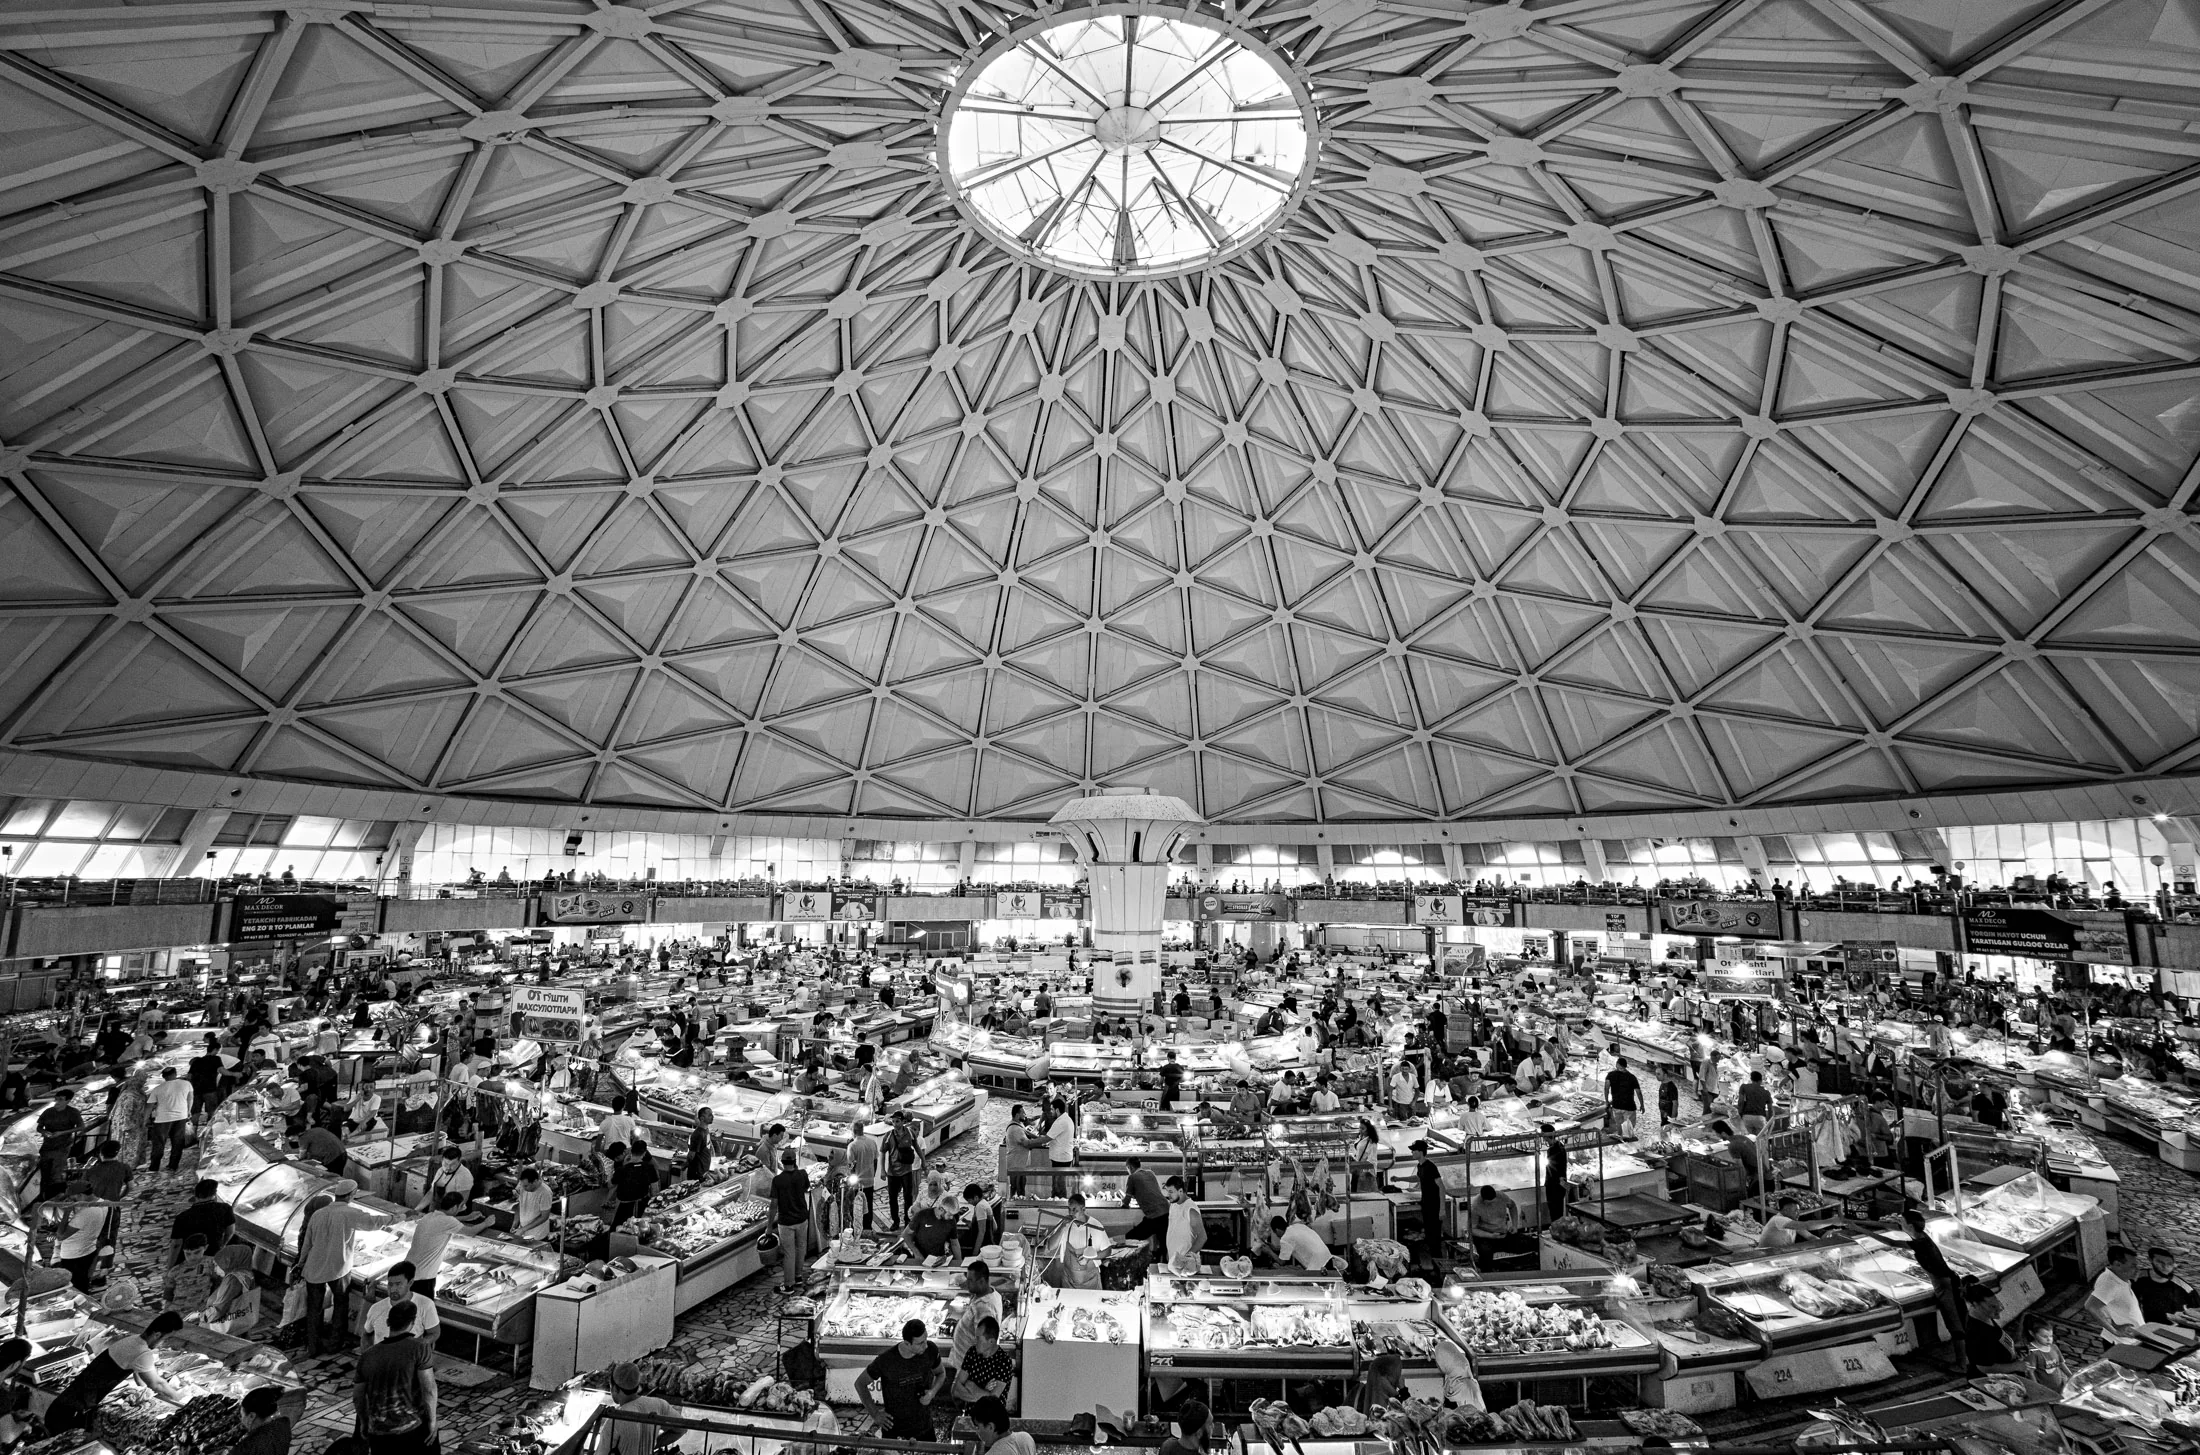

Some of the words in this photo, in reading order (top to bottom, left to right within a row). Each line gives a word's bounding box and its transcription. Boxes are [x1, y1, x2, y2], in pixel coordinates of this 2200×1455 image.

[1971, 938, 2012, 946] YARATILGAN
[528, 990, 541, 1001] ОТ
[517, 1003, 577, 1014] МАХСУЛОТЛАРИ
[1894, 1332, 1909, 1345] 222
[1843, 1358, 1863, 1371] 223
[1774, 1368, 1793, 1383] 224
